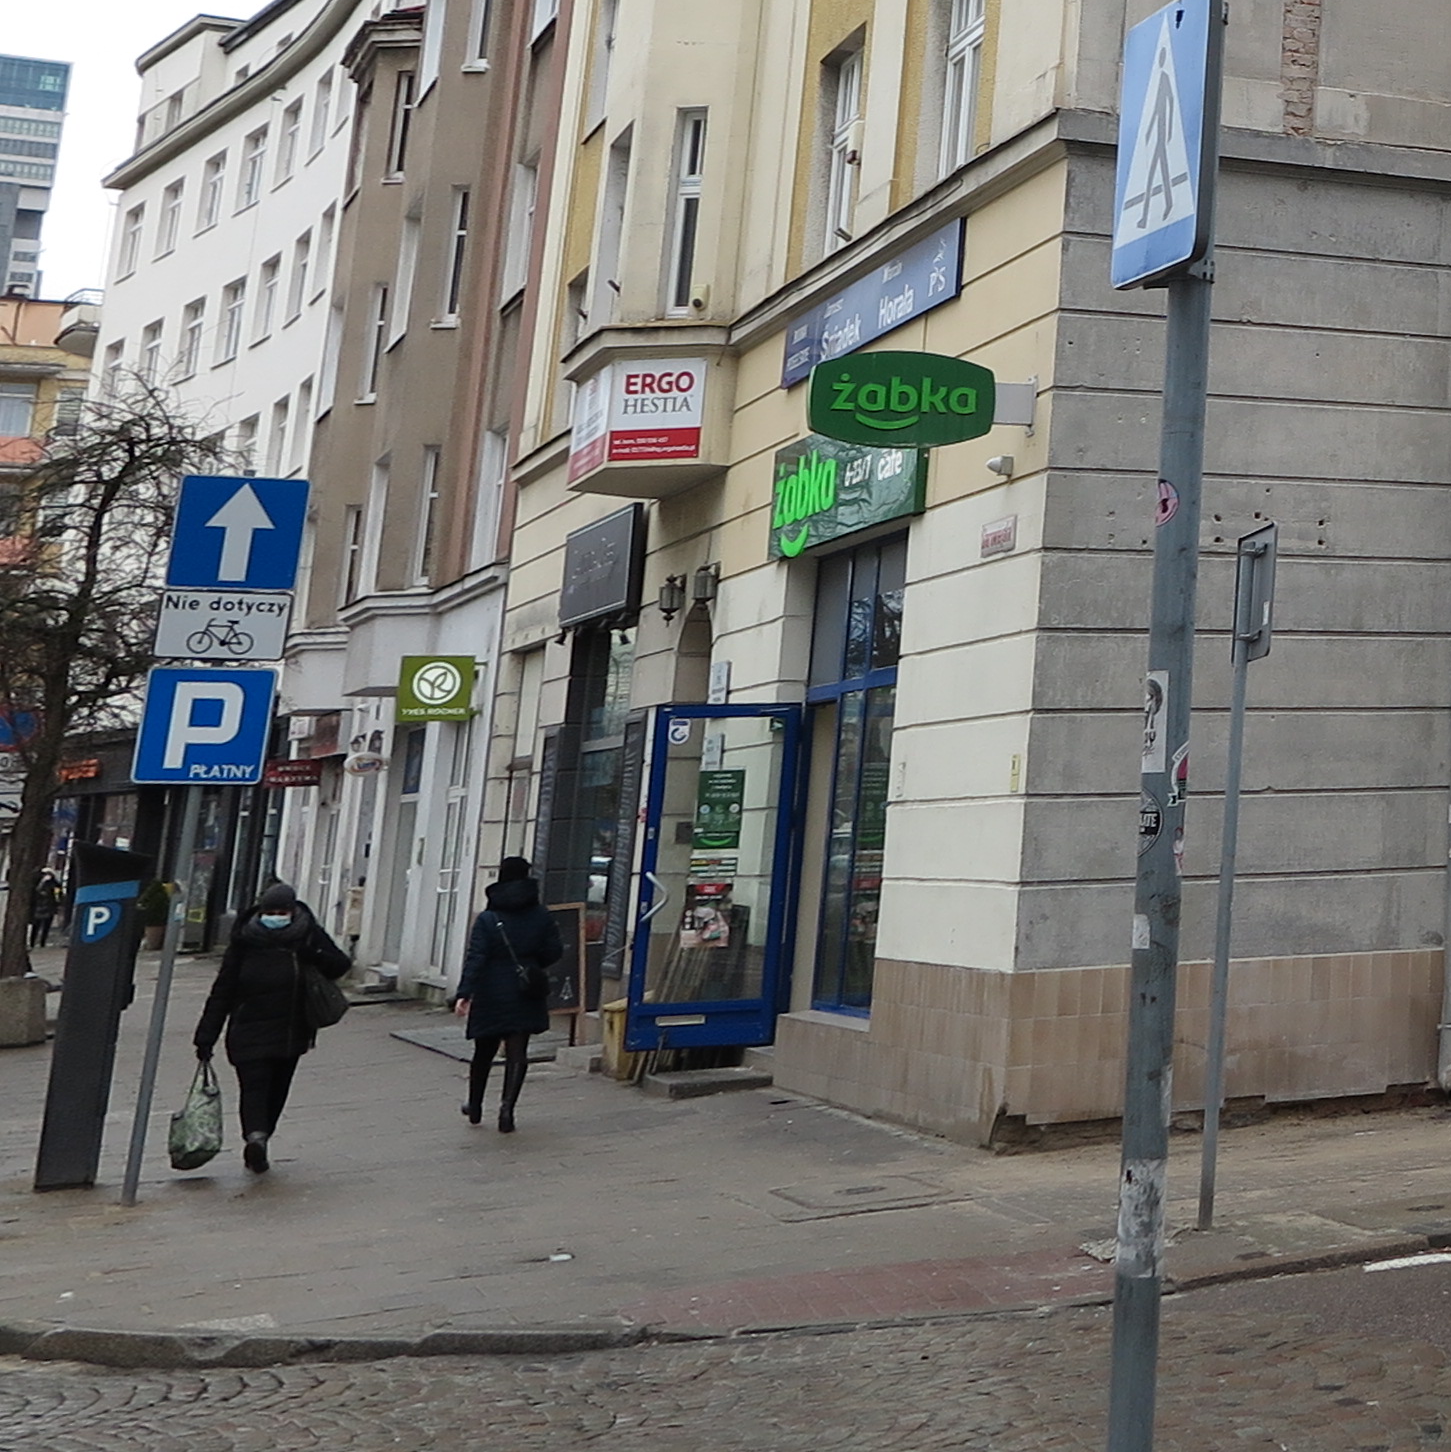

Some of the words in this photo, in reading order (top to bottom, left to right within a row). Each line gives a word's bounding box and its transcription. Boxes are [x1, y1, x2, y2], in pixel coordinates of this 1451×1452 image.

[624, 371, 695, 395] ERGO
[830, 373, 977, 414] żabka
[622, 396, 692, 415] HESTIA
[773, 449, 837, 530] żabka
[164, 595, 200, 611] Nie
[209, 598, 287, 617] dotyczy
[162, 681, 245, 769] P
[189, 764, 255, 779] PŁATNY
[86, 906, 111, 936] P
